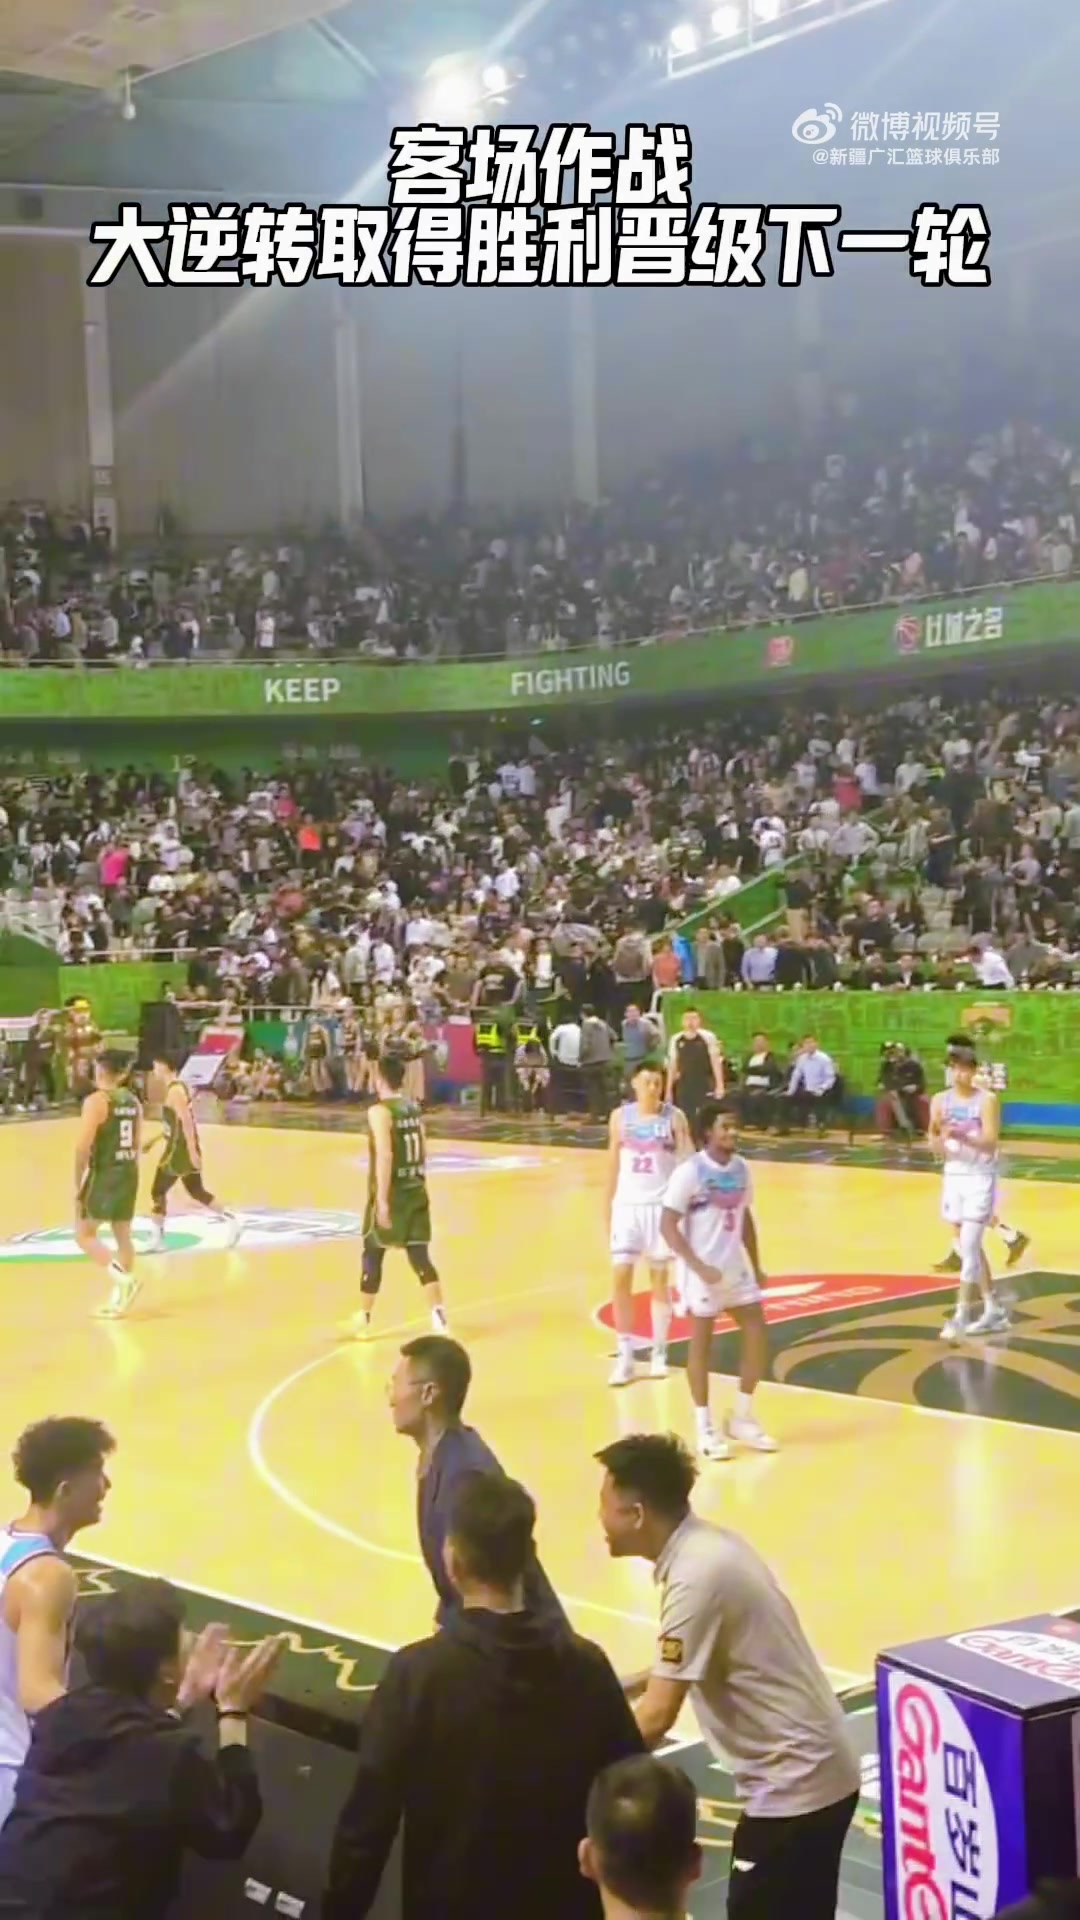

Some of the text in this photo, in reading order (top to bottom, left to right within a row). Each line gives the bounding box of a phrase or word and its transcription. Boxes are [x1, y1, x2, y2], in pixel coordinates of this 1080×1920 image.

[264, 661, 631, 703] KEEP FIGHTING
[119, 1119, 133, 1148] 9
[403, 1132, 420, 1163] 11
[631, 1156, 654, 1174] 22
